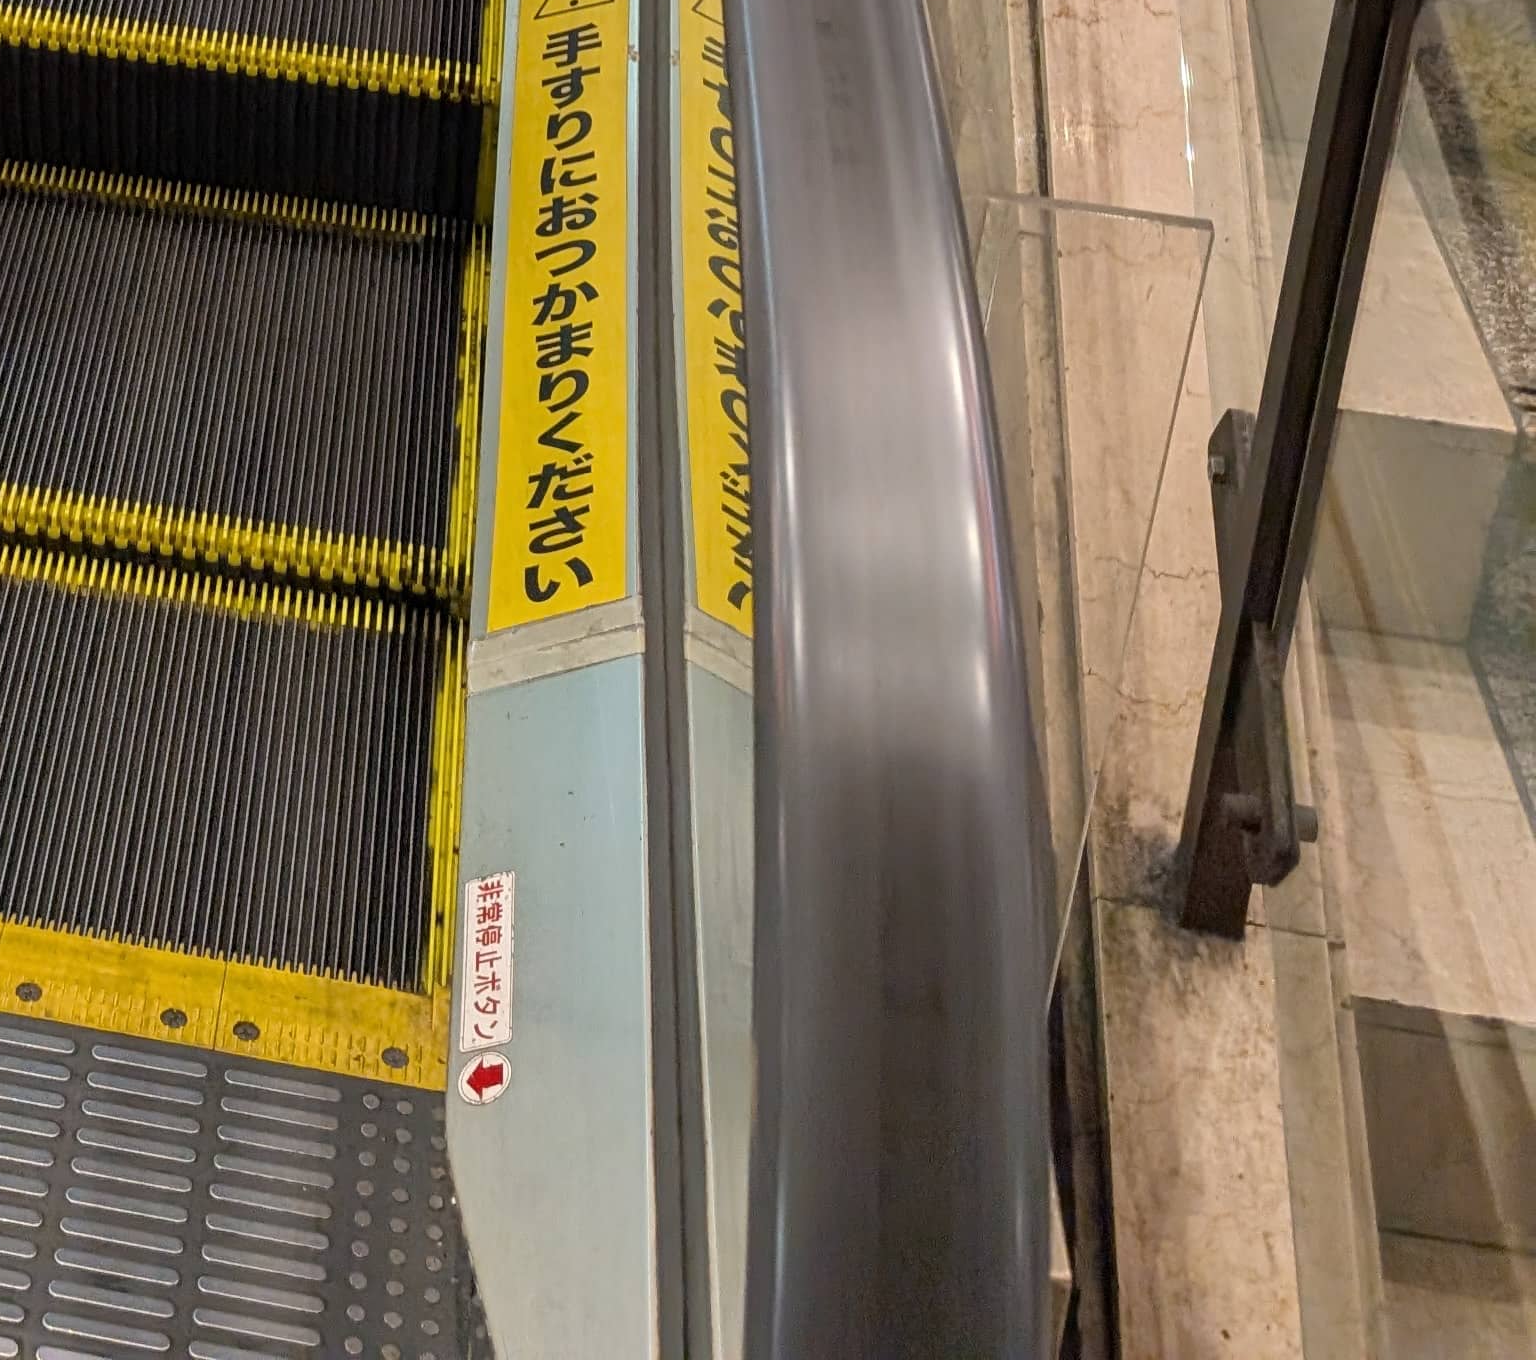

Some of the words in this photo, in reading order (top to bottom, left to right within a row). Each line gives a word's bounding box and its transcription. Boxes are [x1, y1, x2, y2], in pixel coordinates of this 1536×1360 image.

[524, 23, 603, 605] 手すりにおつかまりください
[474, 879, 505, 1040] 非常停止ボタン
